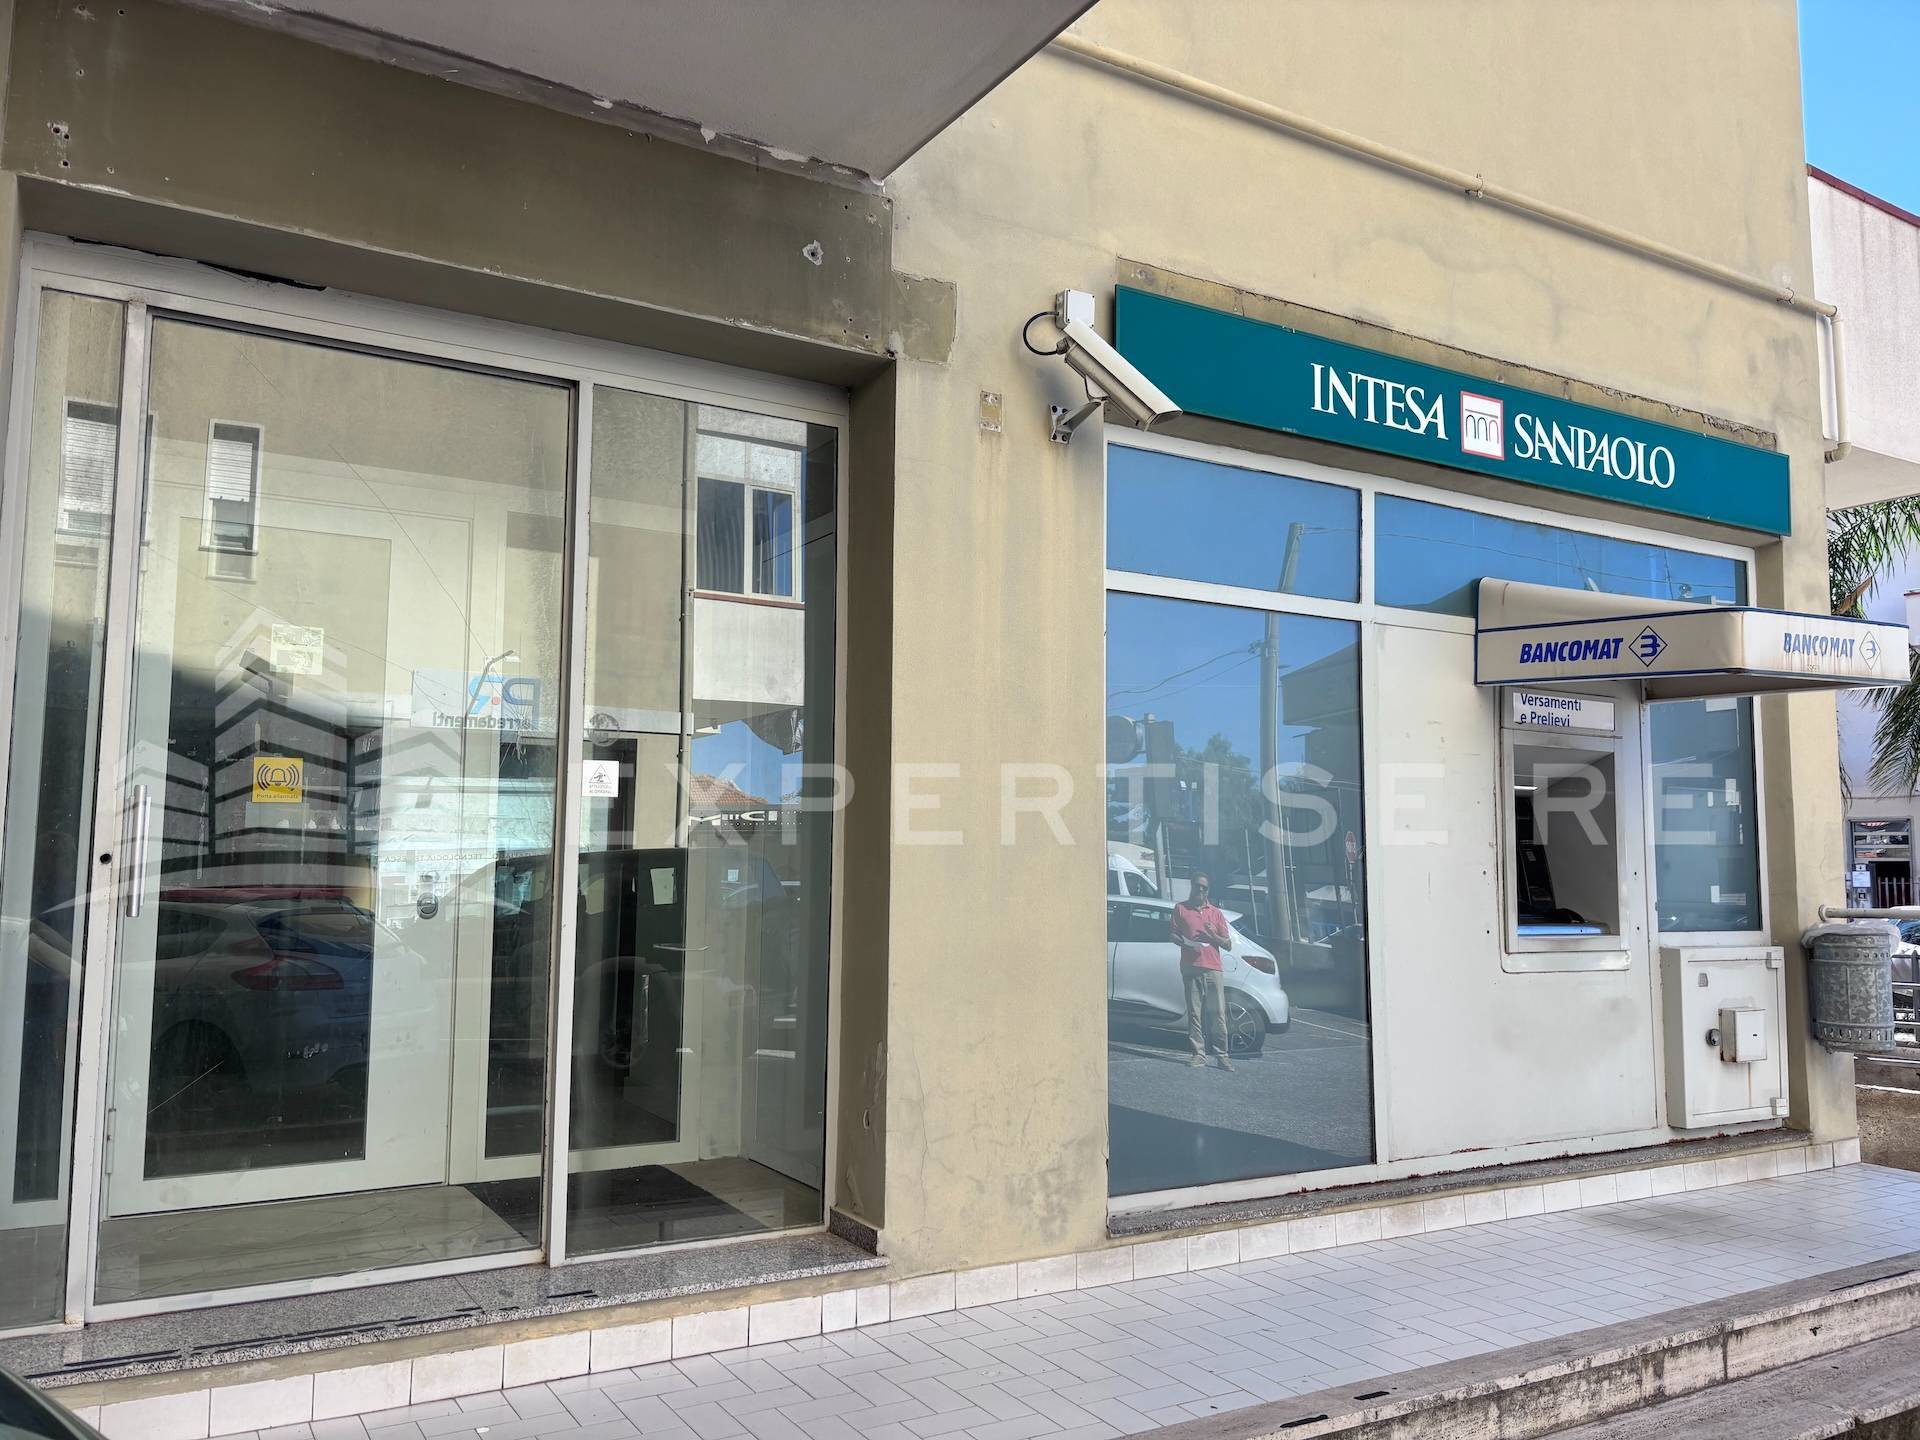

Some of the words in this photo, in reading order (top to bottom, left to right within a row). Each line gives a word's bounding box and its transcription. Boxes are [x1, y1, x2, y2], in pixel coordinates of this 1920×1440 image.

[1310, 362, 1449, 441] INTESA
[1513, 413, 1676, 489] SANPAOLO
[1519, 637, 1624, 664] BANCOMAT
[1783, 632, 1855, 659] BANCOMAT
[1520, 693, 1582, 711] Versamenti
[1520, 713, 1527, 723] e
[1530, 711, 1570, 727] Prelievi
